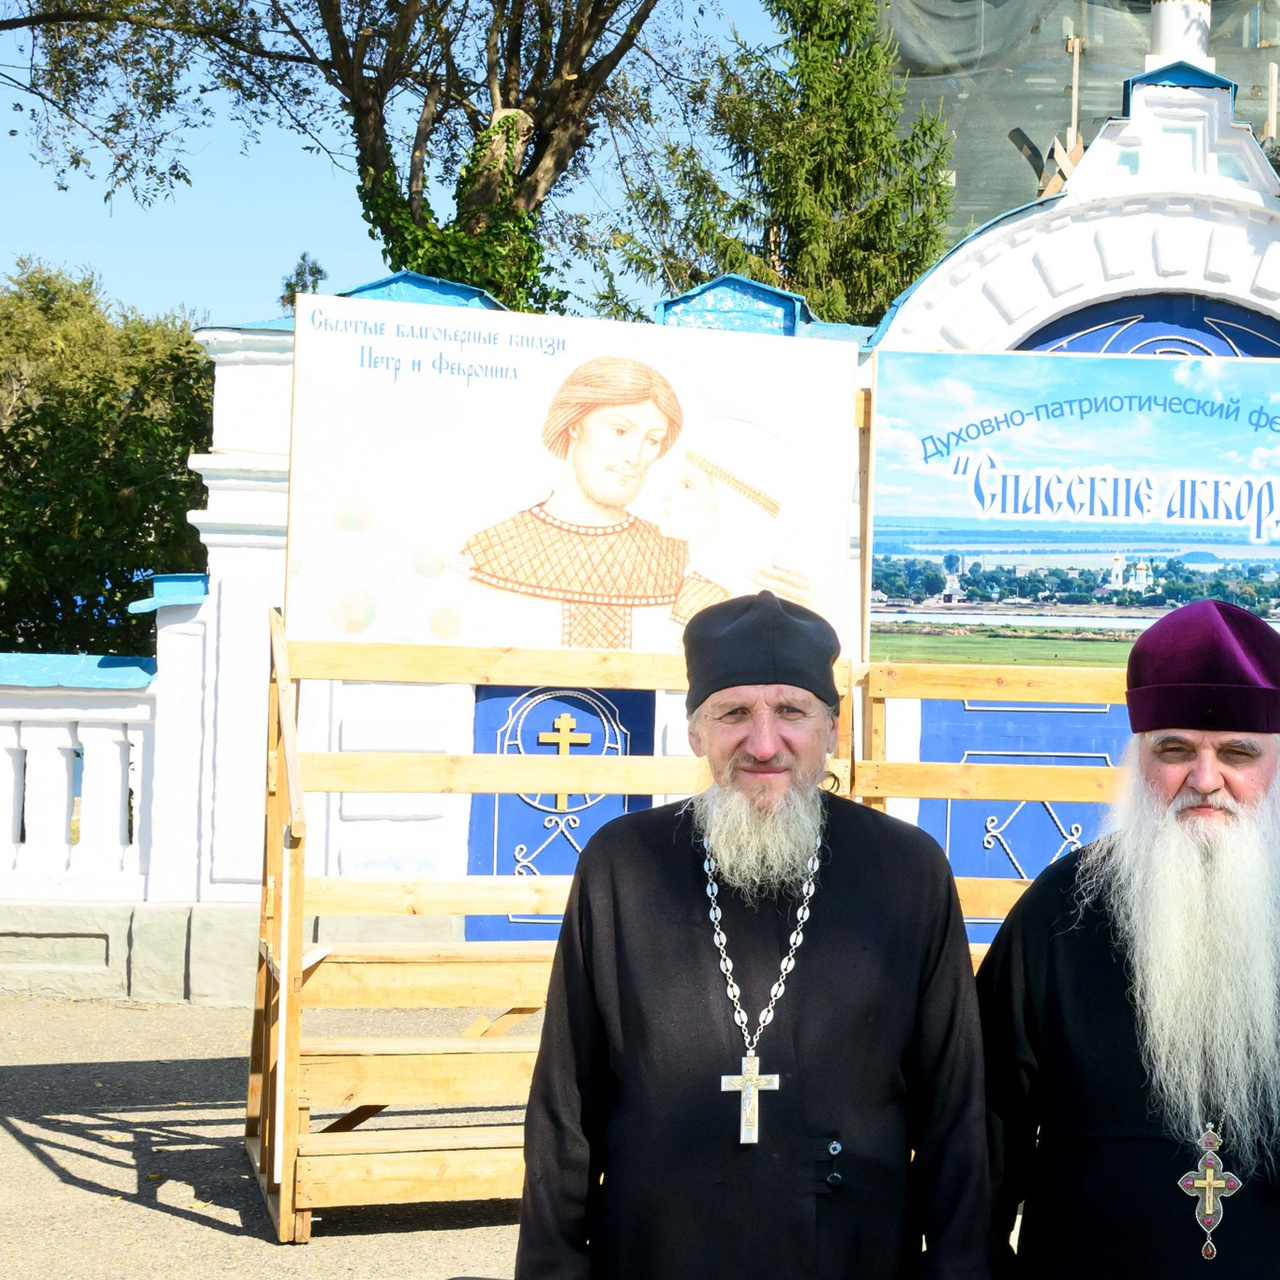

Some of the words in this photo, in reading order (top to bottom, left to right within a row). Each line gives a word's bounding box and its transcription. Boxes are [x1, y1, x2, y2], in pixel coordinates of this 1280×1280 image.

[360, 344, 402, 383] Петр
[411, 358, 422, 373] и
[920, 394, 1242, 465] Духовно-патриотический
[952, 452, 1155, 518] "Спасские
